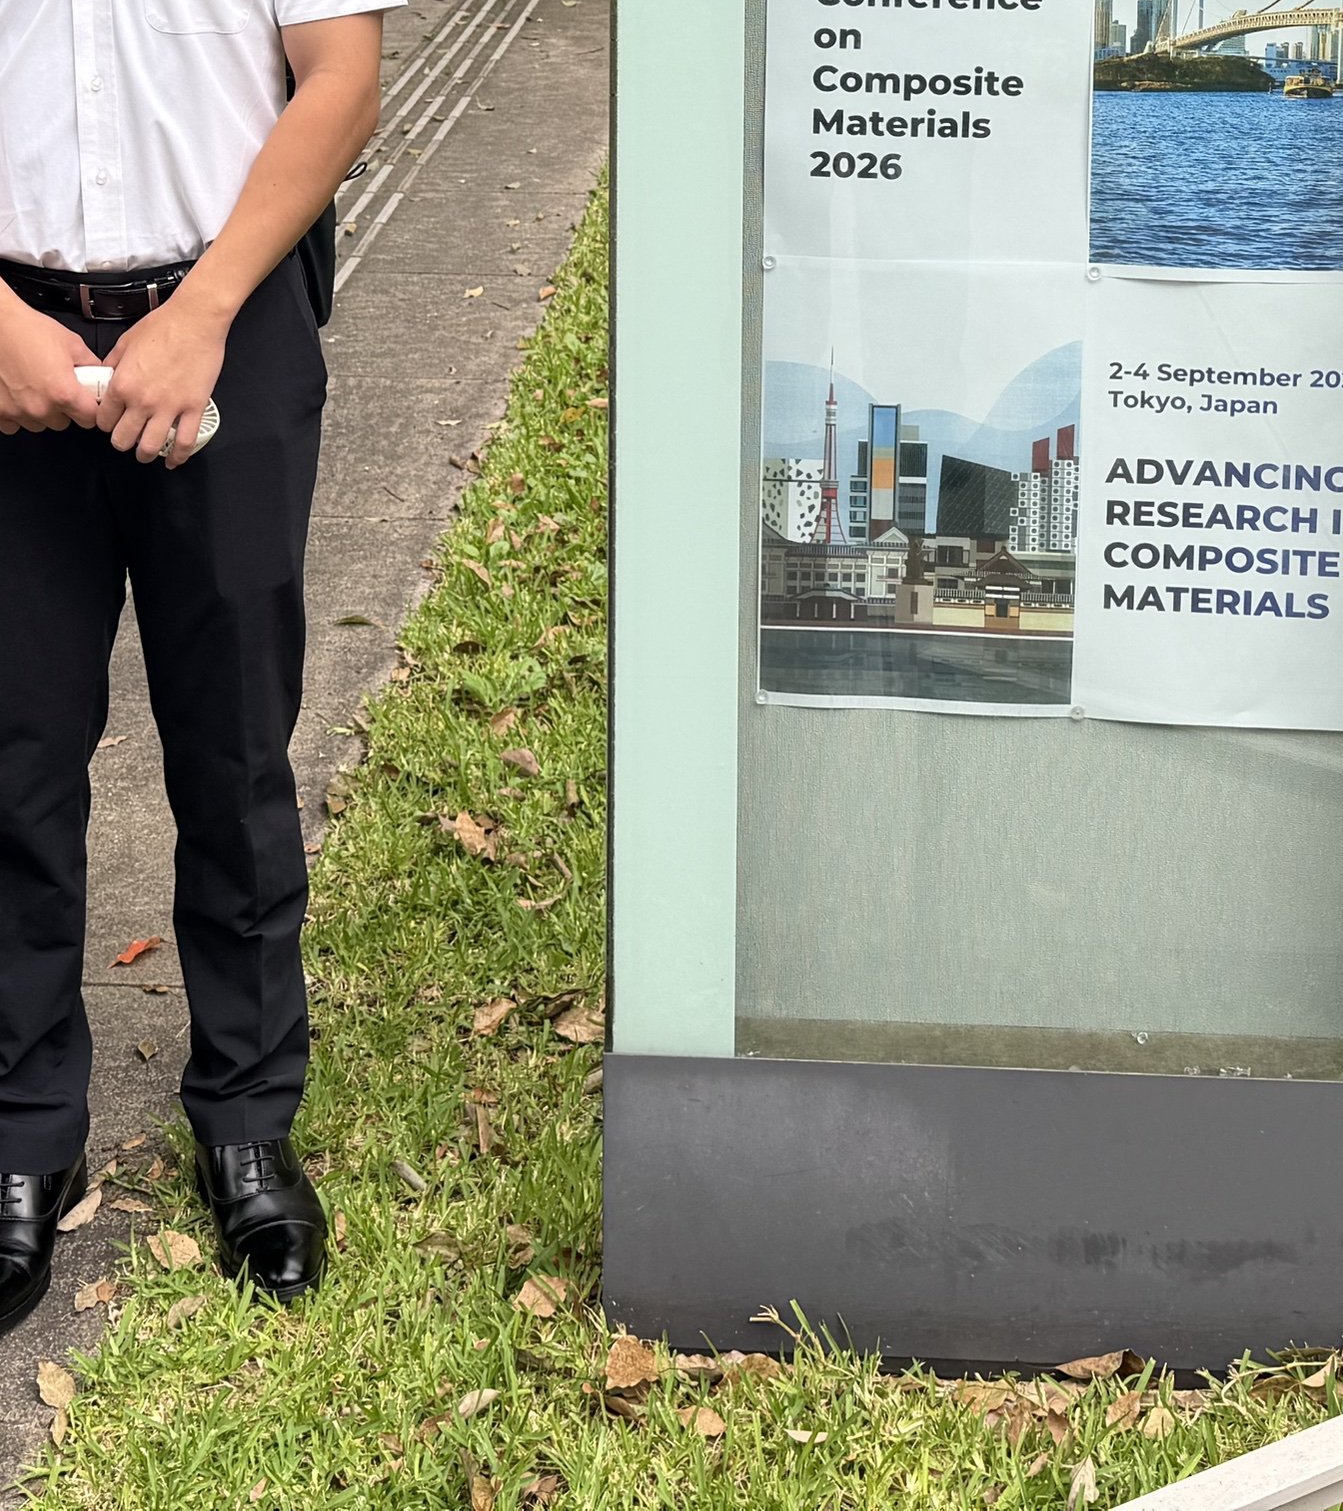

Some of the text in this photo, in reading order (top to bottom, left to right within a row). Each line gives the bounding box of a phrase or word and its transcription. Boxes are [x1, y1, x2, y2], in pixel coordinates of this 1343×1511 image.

[813, 27, 861, 49] on
[812, 64, 1023, 101] Composite
[812, 108, 990, 138] Materials
[809, 150, 902, 180] 2026
[1109, 361, 1149, 380] 2-4
[1157, 363, 1302, 386] September
[1107, 390, 1277, 417] Tokyo, Japan
[1105, 499, 1317, 533] RESEARCH
[1103, 541, 1339, 577] COMPOSITE
[1103, 583, 1329, 619] MATERIALS
